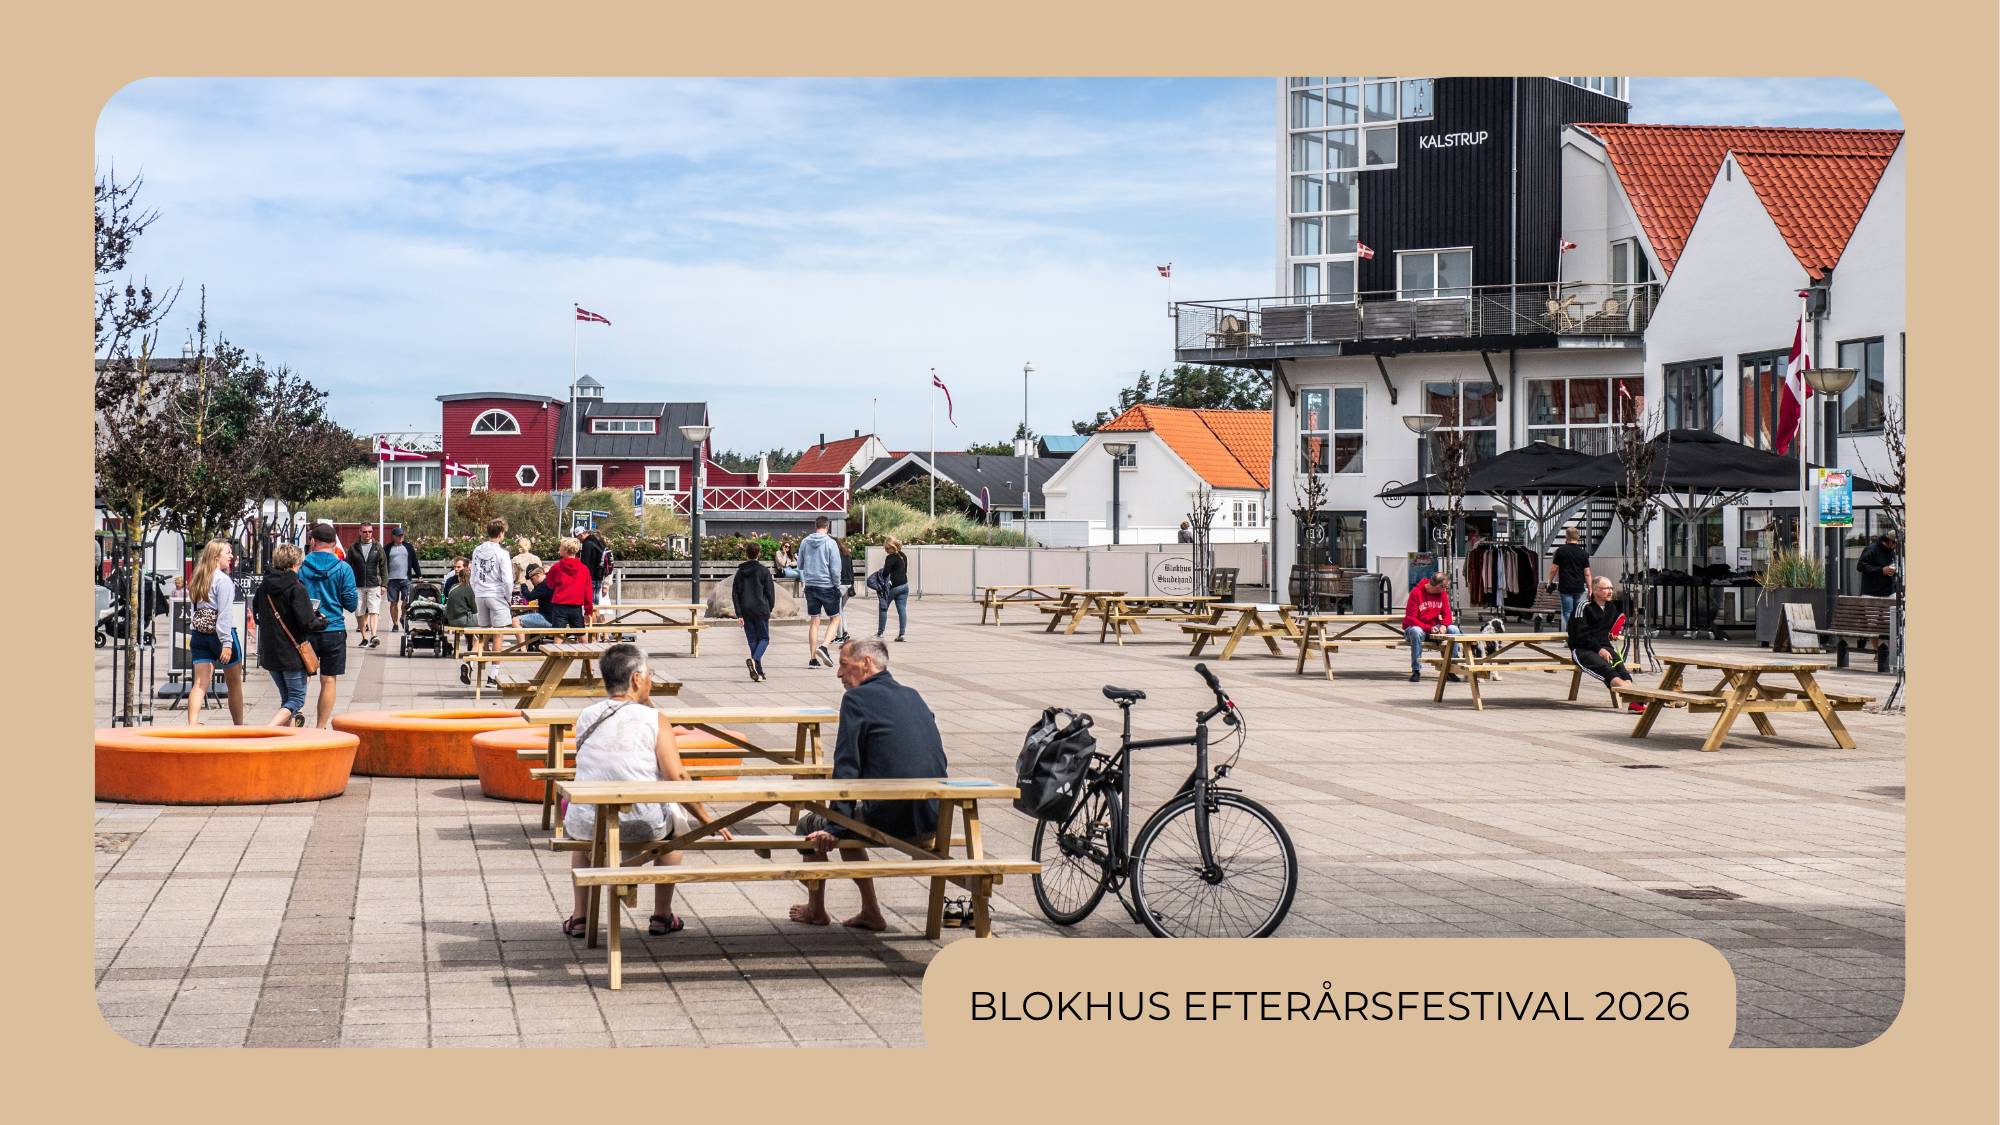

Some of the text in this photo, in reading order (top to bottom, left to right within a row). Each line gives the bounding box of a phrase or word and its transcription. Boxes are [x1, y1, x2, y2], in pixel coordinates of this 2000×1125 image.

[1419, 131, 1488, 149] KALSTRUP
[635, 490, 641, 504] P
[1164, 563, 1192, 573] Blokhus
[1157, 574, 1196, 585] Skudehand
